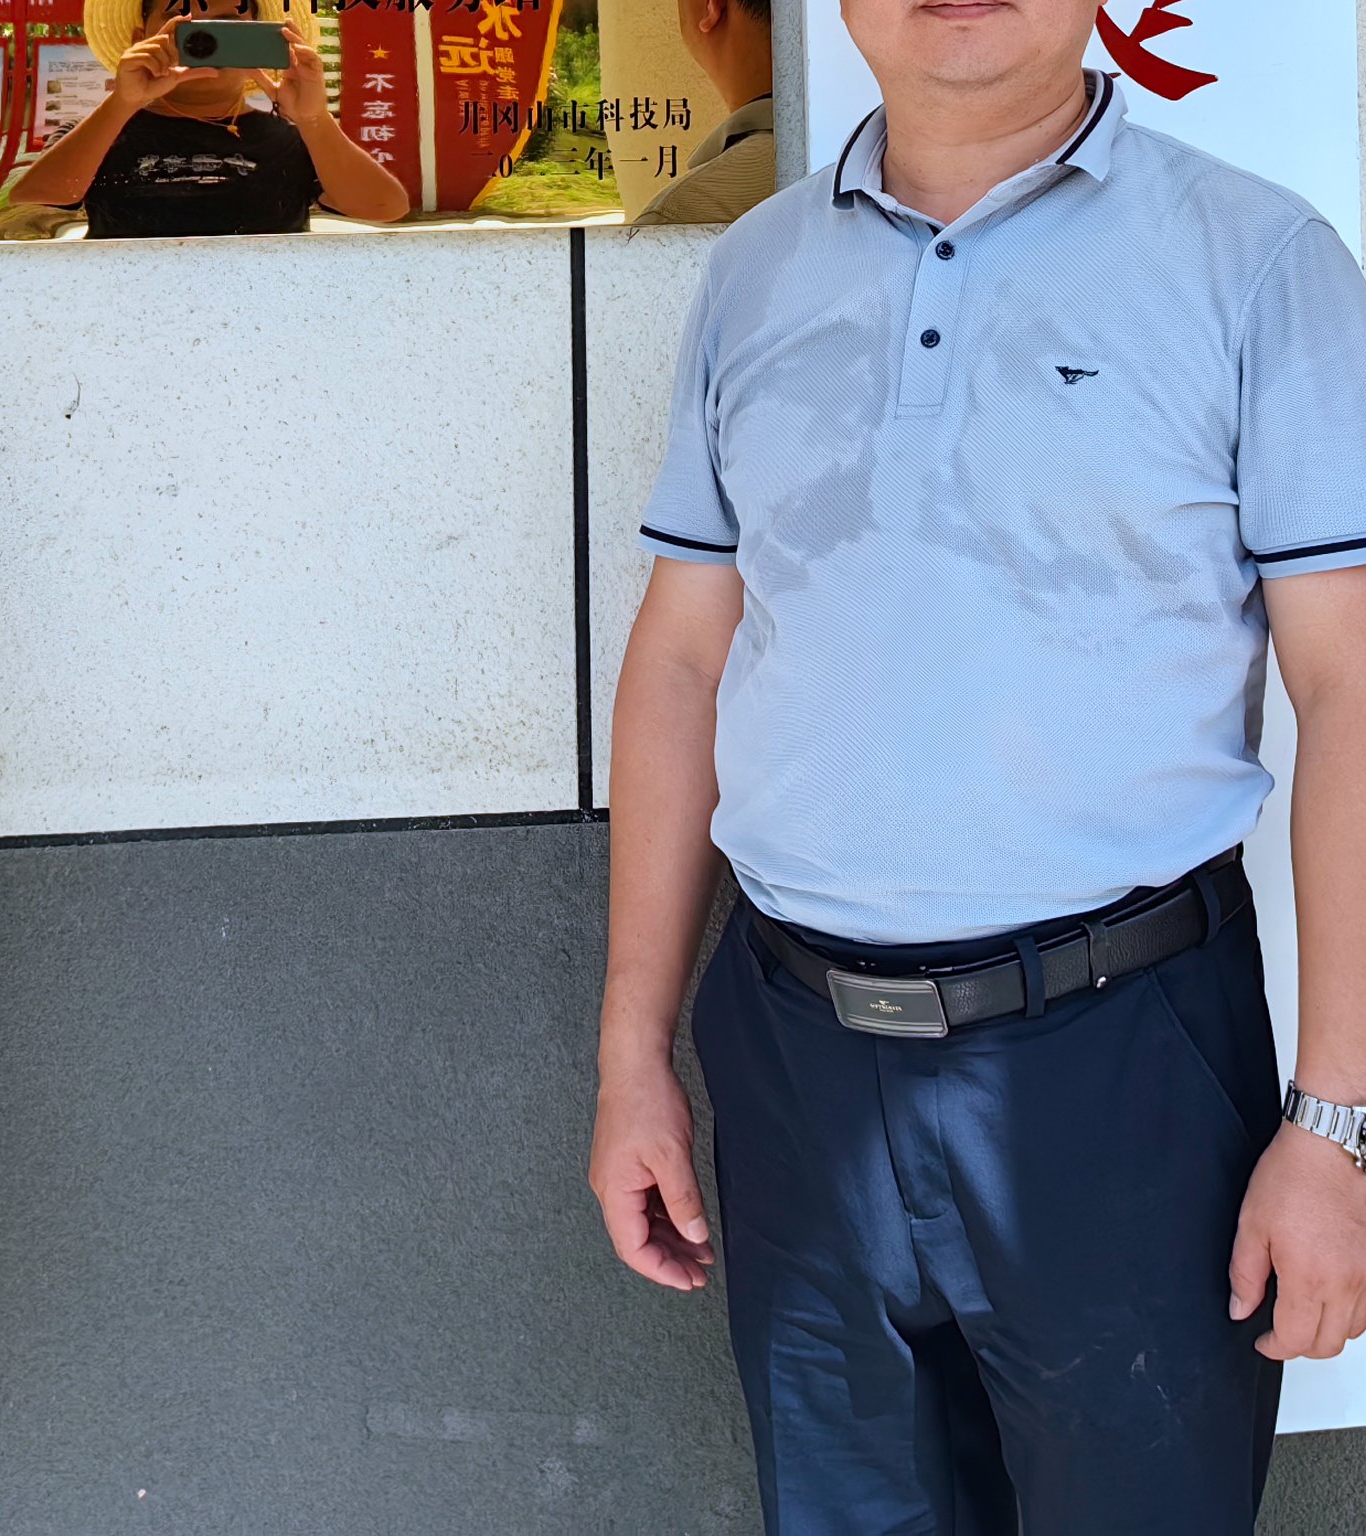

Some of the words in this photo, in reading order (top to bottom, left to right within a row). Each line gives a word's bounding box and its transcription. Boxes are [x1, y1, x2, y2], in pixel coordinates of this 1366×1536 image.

[459, 97, 692, 135] 井冈山市科技局
